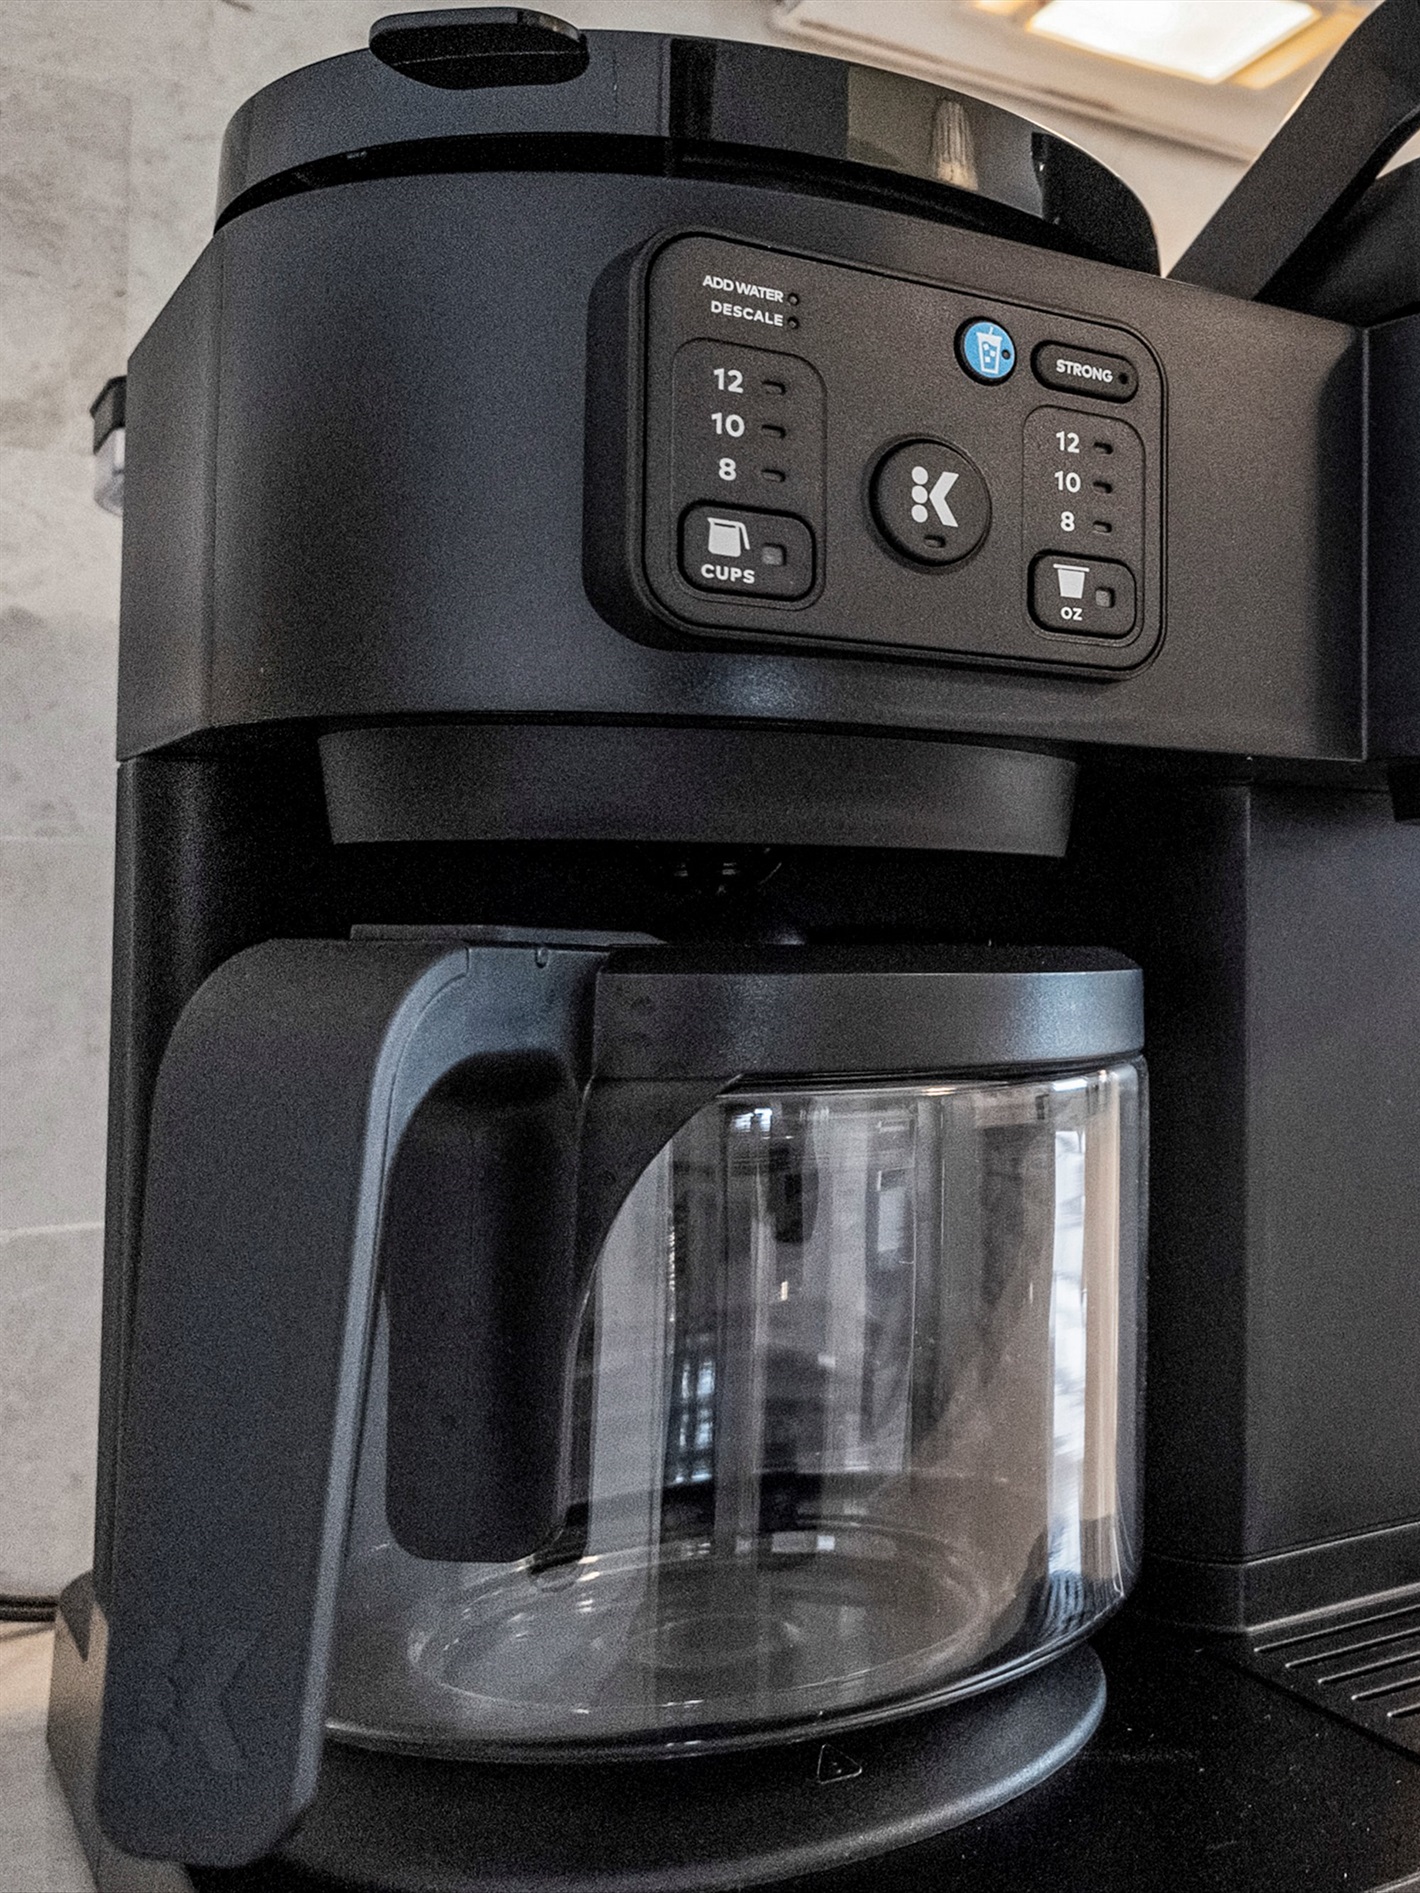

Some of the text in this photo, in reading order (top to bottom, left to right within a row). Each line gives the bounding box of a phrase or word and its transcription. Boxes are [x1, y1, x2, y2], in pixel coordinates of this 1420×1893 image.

[702, 274, 785, 303] ADD WATER
[710, 300, 784, 327] DESCALE
[713, 367, 744, 394] 12
[1056, 358, 1114, 383] STRONG
[711, 412, 745, 438] 10
[1055, 430, 1080, 454] 12
[718, 457, 737, 481] 8
[1054, 470, 1081, 493] 10
[1060, 510, 1075, 532] 8
[700, 563, 755, 585] CUPS
[1060, 606, 1083, 622] OZ
